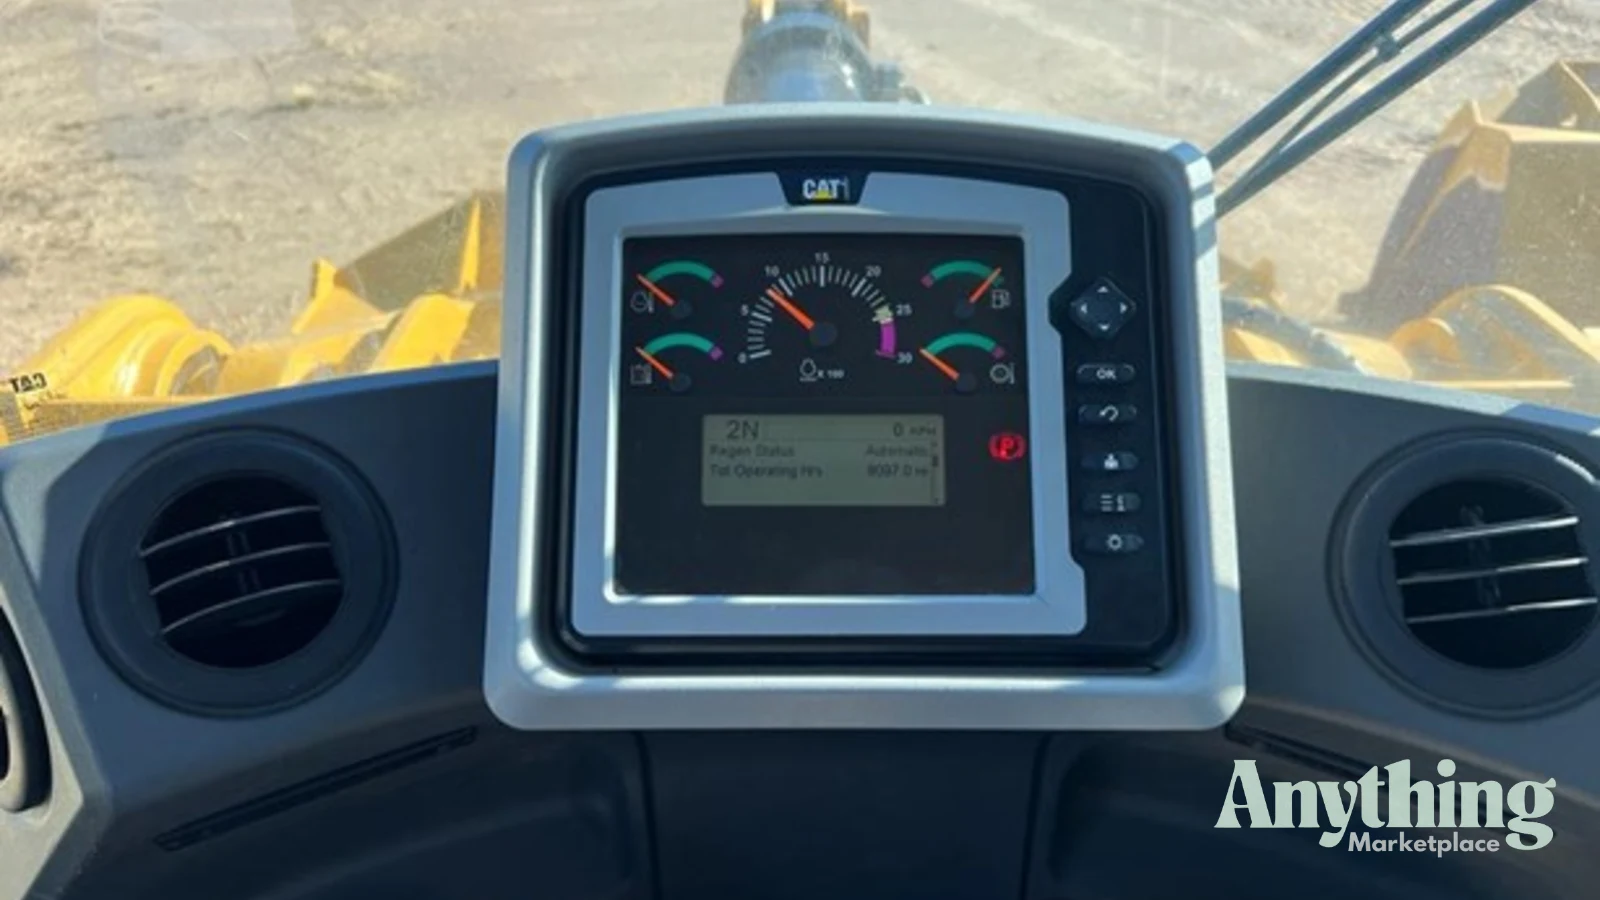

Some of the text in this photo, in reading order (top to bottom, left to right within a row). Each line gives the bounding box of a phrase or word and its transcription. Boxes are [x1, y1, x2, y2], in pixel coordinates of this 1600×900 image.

[802, 178, 840, 199] CAT
[815, 252, 830, 264] 15
[765, 266, 780, 277] 10
[866, 266, 882, 277] 20
[741, 305, 749, 316] 5
[896, 305, 912, 316] 25
[897, 353, 912, 364] 30
[1096, 368, 1116, 380] OK
[726, 419, 759, 440] 2N
[892, 421, 905, 437] 0
[755, 444, 795, 457] Status
[734, 464, 798, 480] Operating
